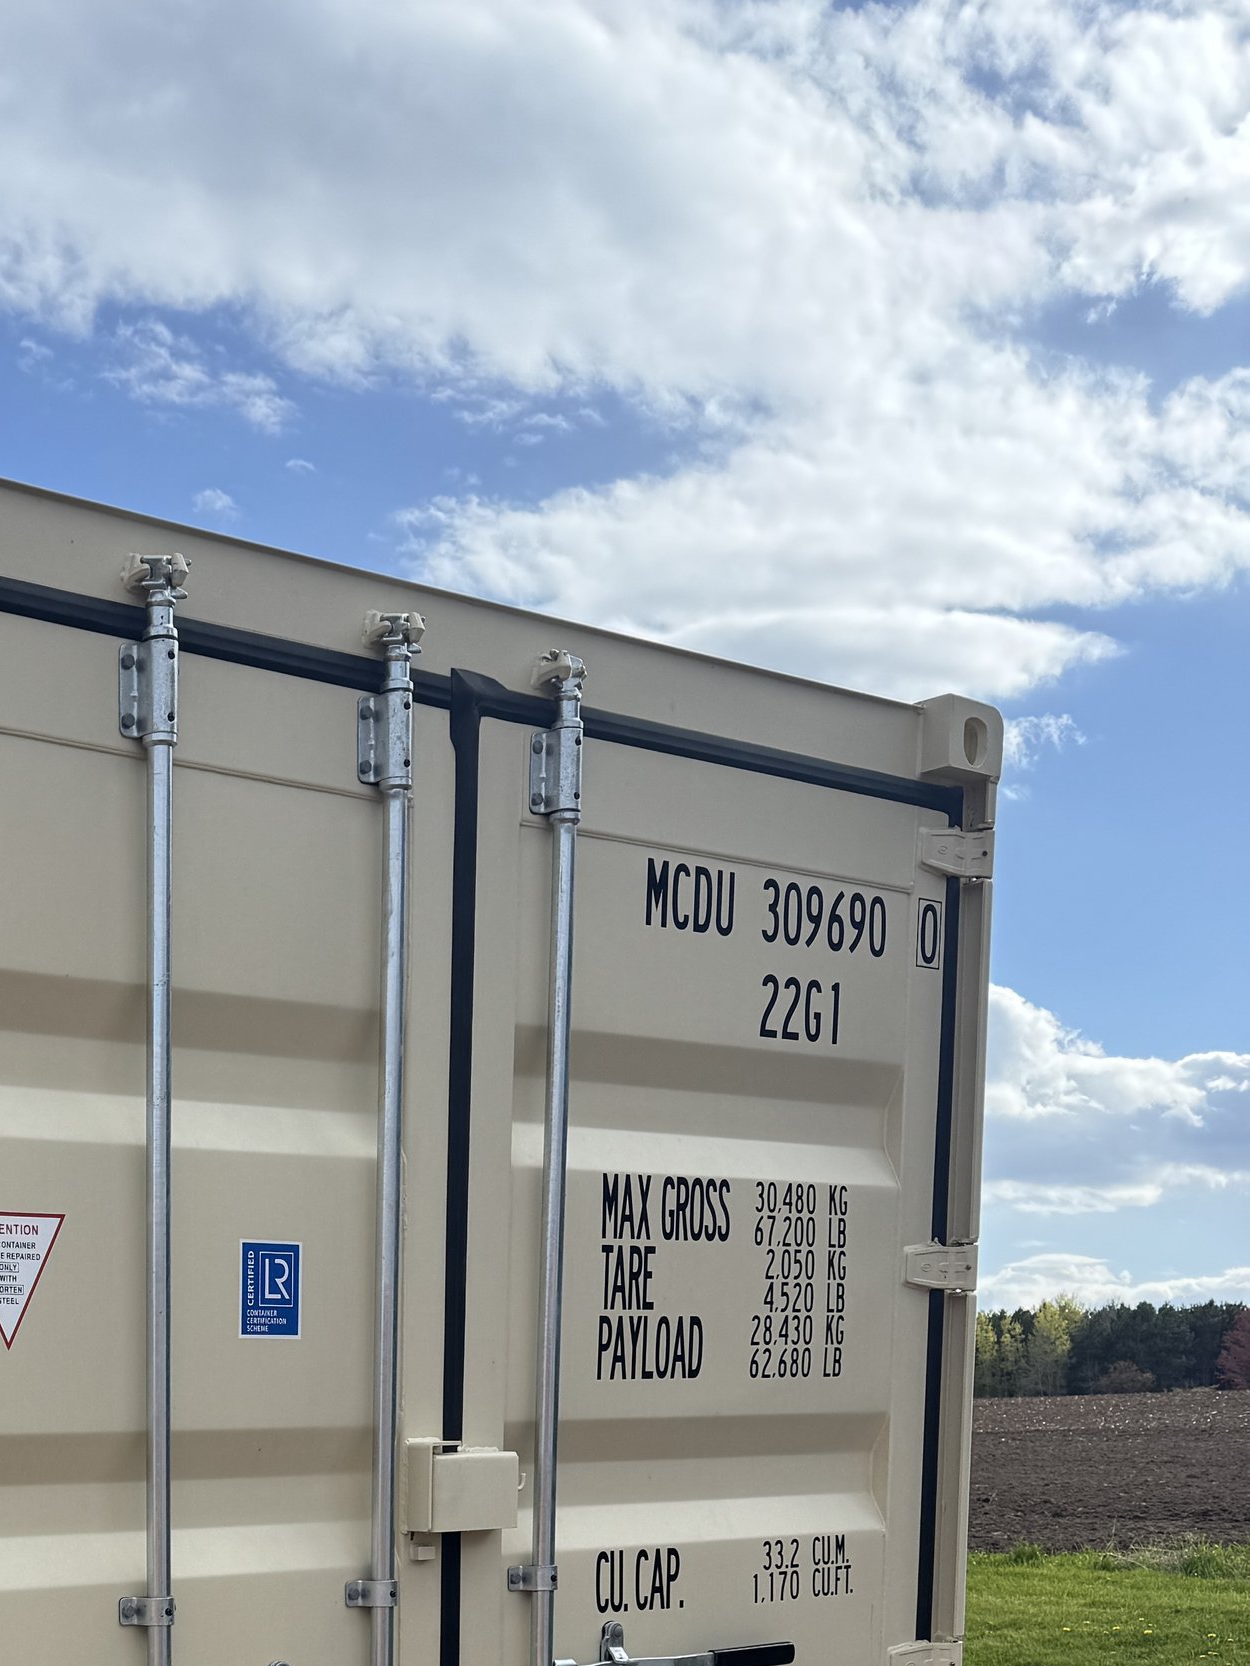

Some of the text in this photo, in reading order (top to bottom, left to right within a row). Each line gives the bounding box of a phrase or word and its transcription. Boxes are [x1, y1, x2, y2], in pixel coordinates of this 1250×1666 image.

[645, 858, 939, 965] MCDU 309690 0
[759, 973, 841, 1045] 22G1
[602, 1173, 731, 1243] MAX GROSS
[755, 1182, 848, 1218] 30,480 KG
[753, 1216, 847, 1249] 67,200 LB
[6, 1252, 41, 1261] REPAIRED
[764, 1249, 847, 1283] 2,050 KG
[0, 1275, 17, 1283] WITH
[247, 1250, 255, 1306] CERTIFIED
[264, 1258, 290, 1299] LR
[601, 1245, 656, 1311] TARE
[246, 1309, 278, 1317] CONTAINER
[762, 1282, 845, 1316] 4,520 LB
[246, 1317, 287, 1325] CERTIFICATION
[750, 1314, 845, 1349] 28,430 KG
[596, 1315, 703, 1380] PAYLOAD
[749, 1346, 842, 1380] 62,680 LB
[762, 1534, 850, 1571] 33.2 CU.M.
[595, 1547, 685, 1614] CU. CAP.
[752, 1564, 854, 1604] 1,170 CU.FT.
